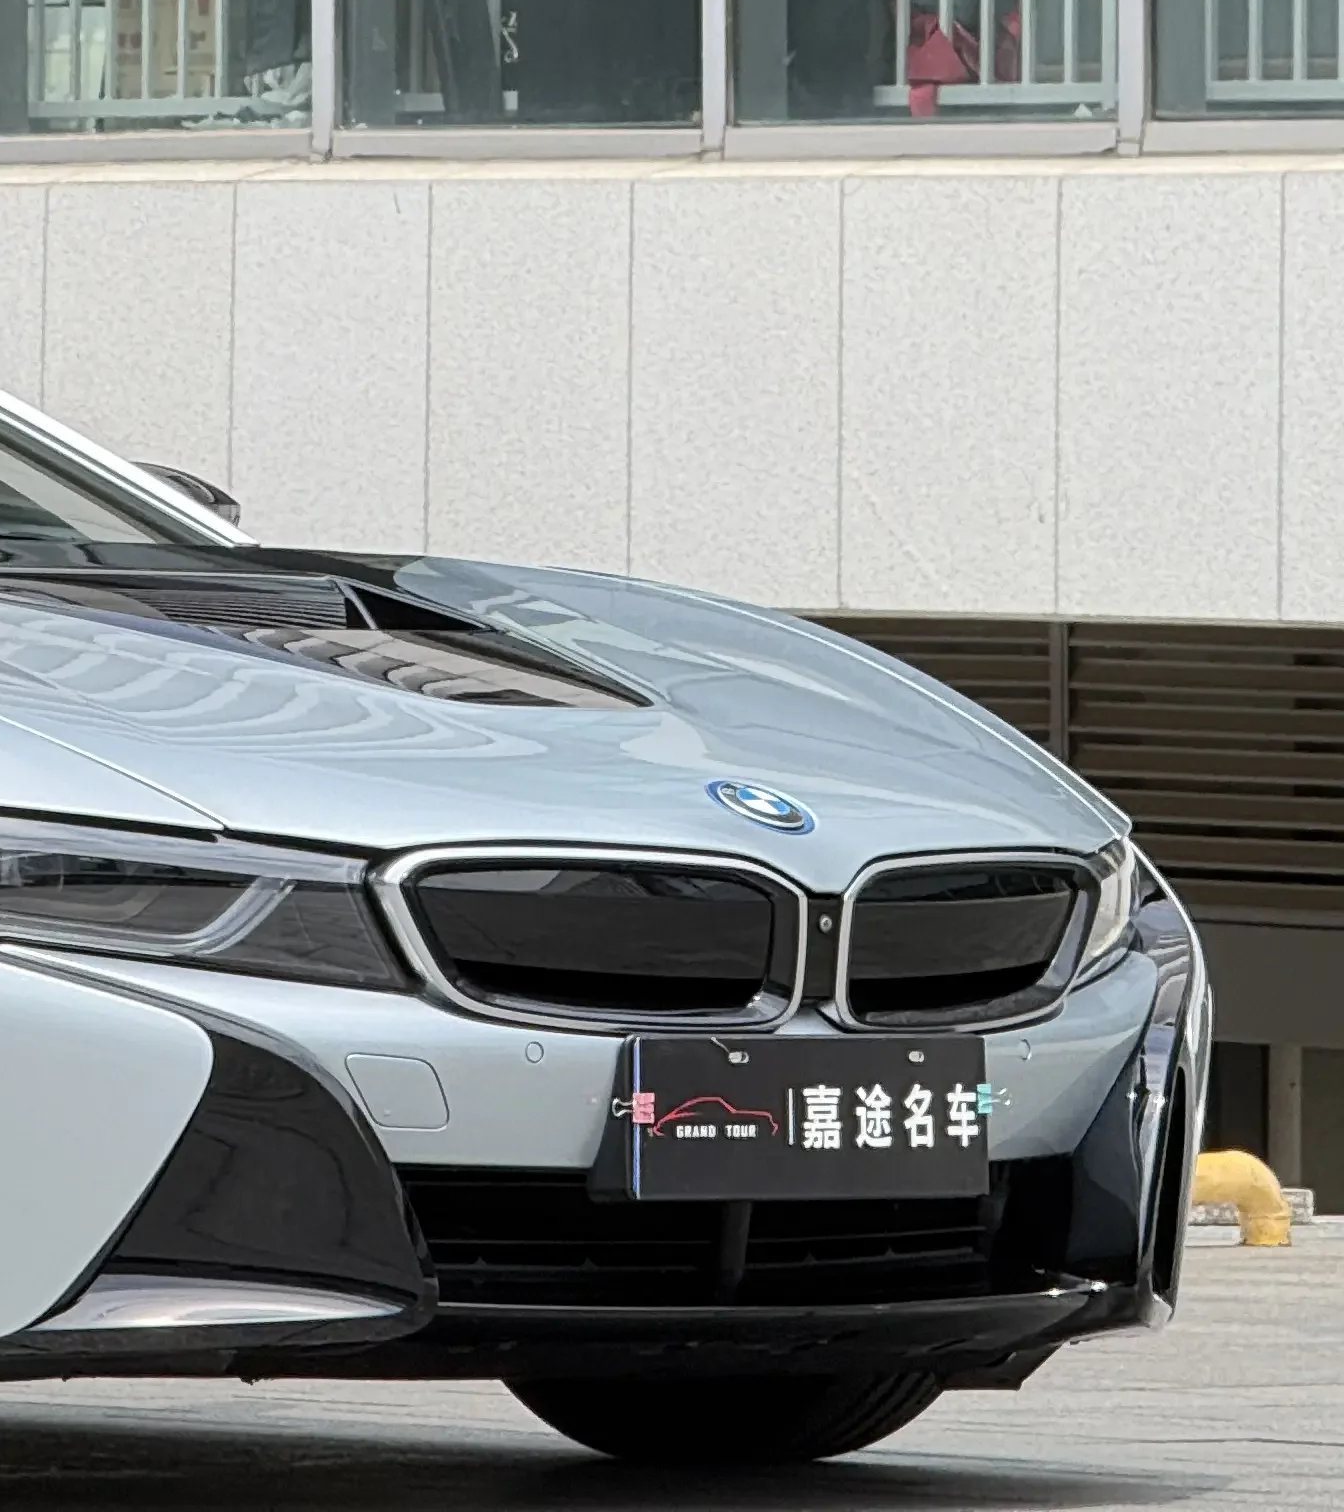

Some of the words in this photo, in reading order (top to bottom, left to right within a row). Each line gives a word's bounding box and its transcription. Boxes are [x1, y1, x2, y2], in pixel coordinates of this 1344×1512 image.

[675, 1124, 717, 1139] GRAND
[725, 1124, 757, 1139] TOUR
[802, 1083, 979, 1149] 嘉途名车
